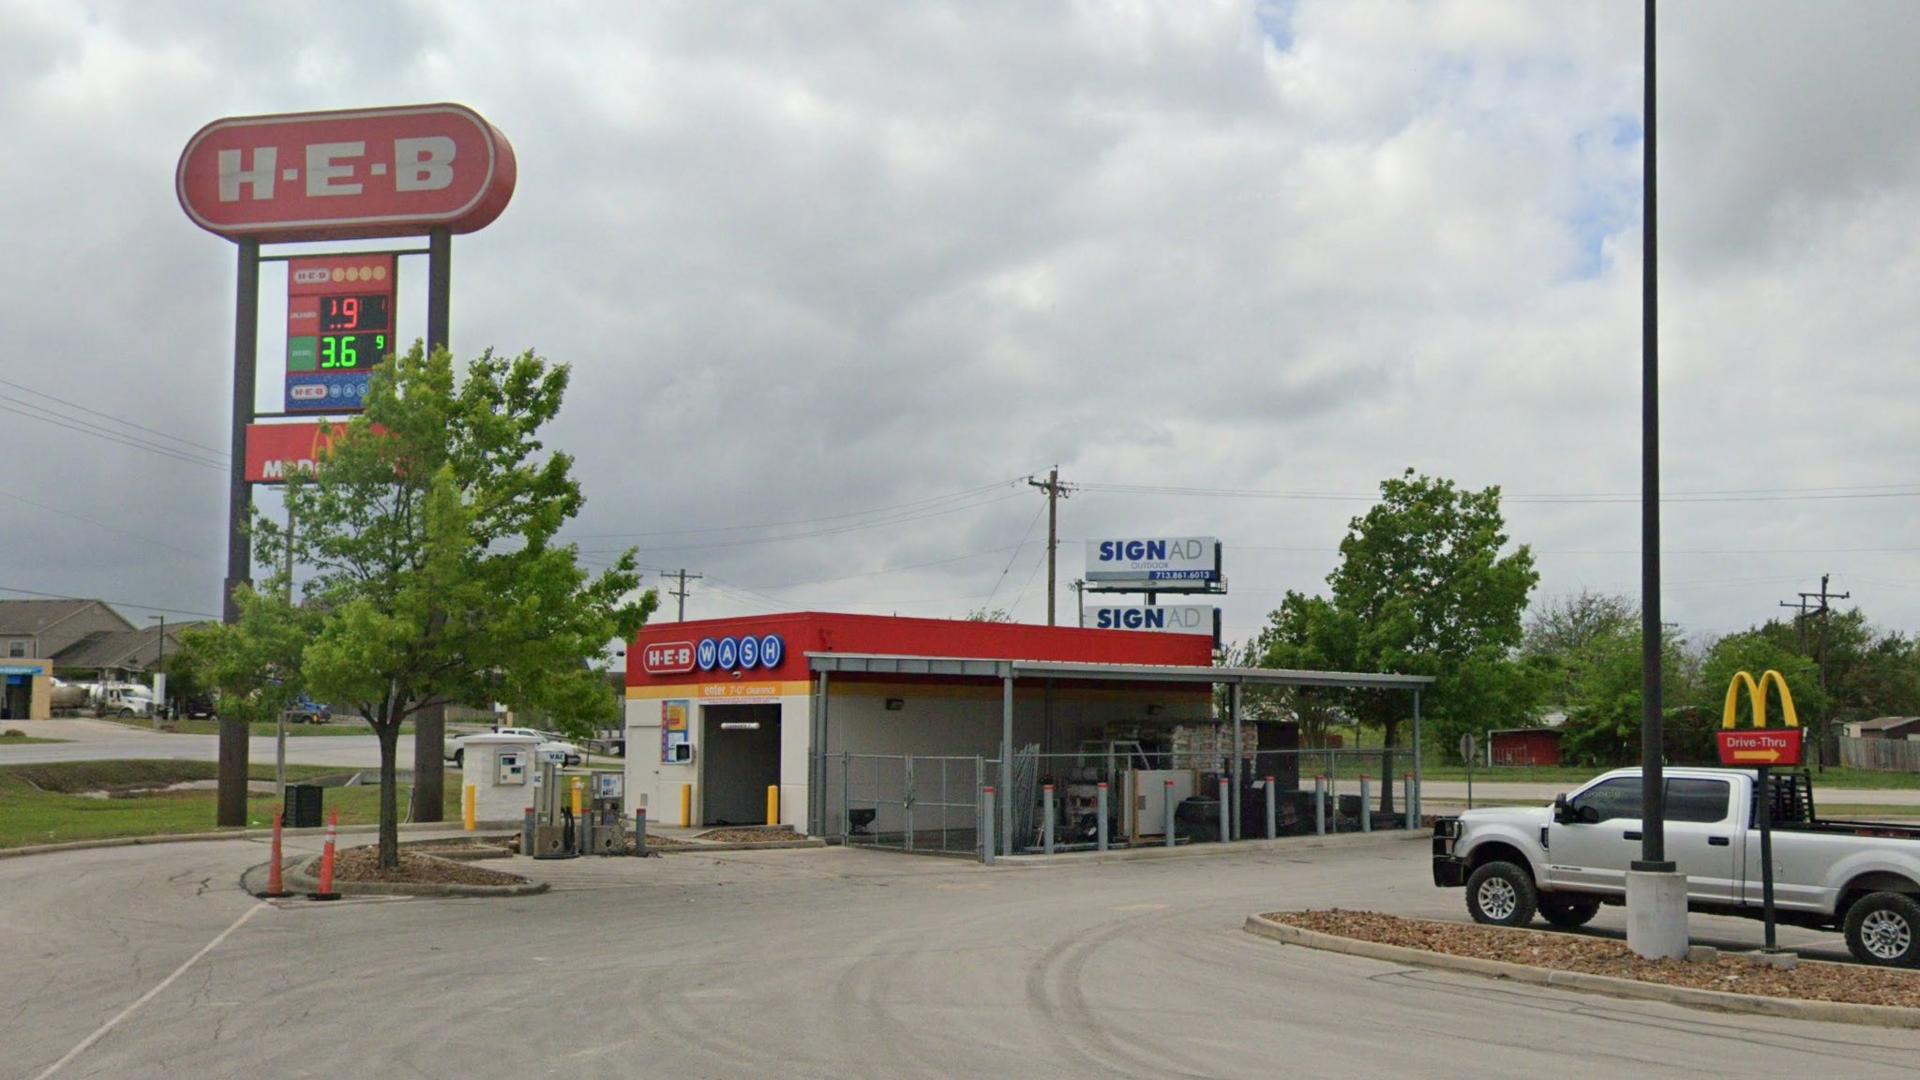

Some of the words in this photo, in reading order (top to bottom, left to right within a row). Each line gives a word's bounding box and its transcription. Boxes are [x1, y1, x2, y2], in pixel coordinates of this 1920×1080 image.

[321, 335, 357, 368] 3.6
[376, 335, 385, 349] 9
[1099, 540, 1166, 561] SIGN
[1169, 540, 1202, 560] AD
[1155, 571, 1210, 579] 713.861.6013
[1097, 608, 1164, 629] SIGN
[1167, 608, 1200, 628] AD
[700, 642, 776, 663] WASH
[1727, 737, 1787, 748] Drive-Thru
